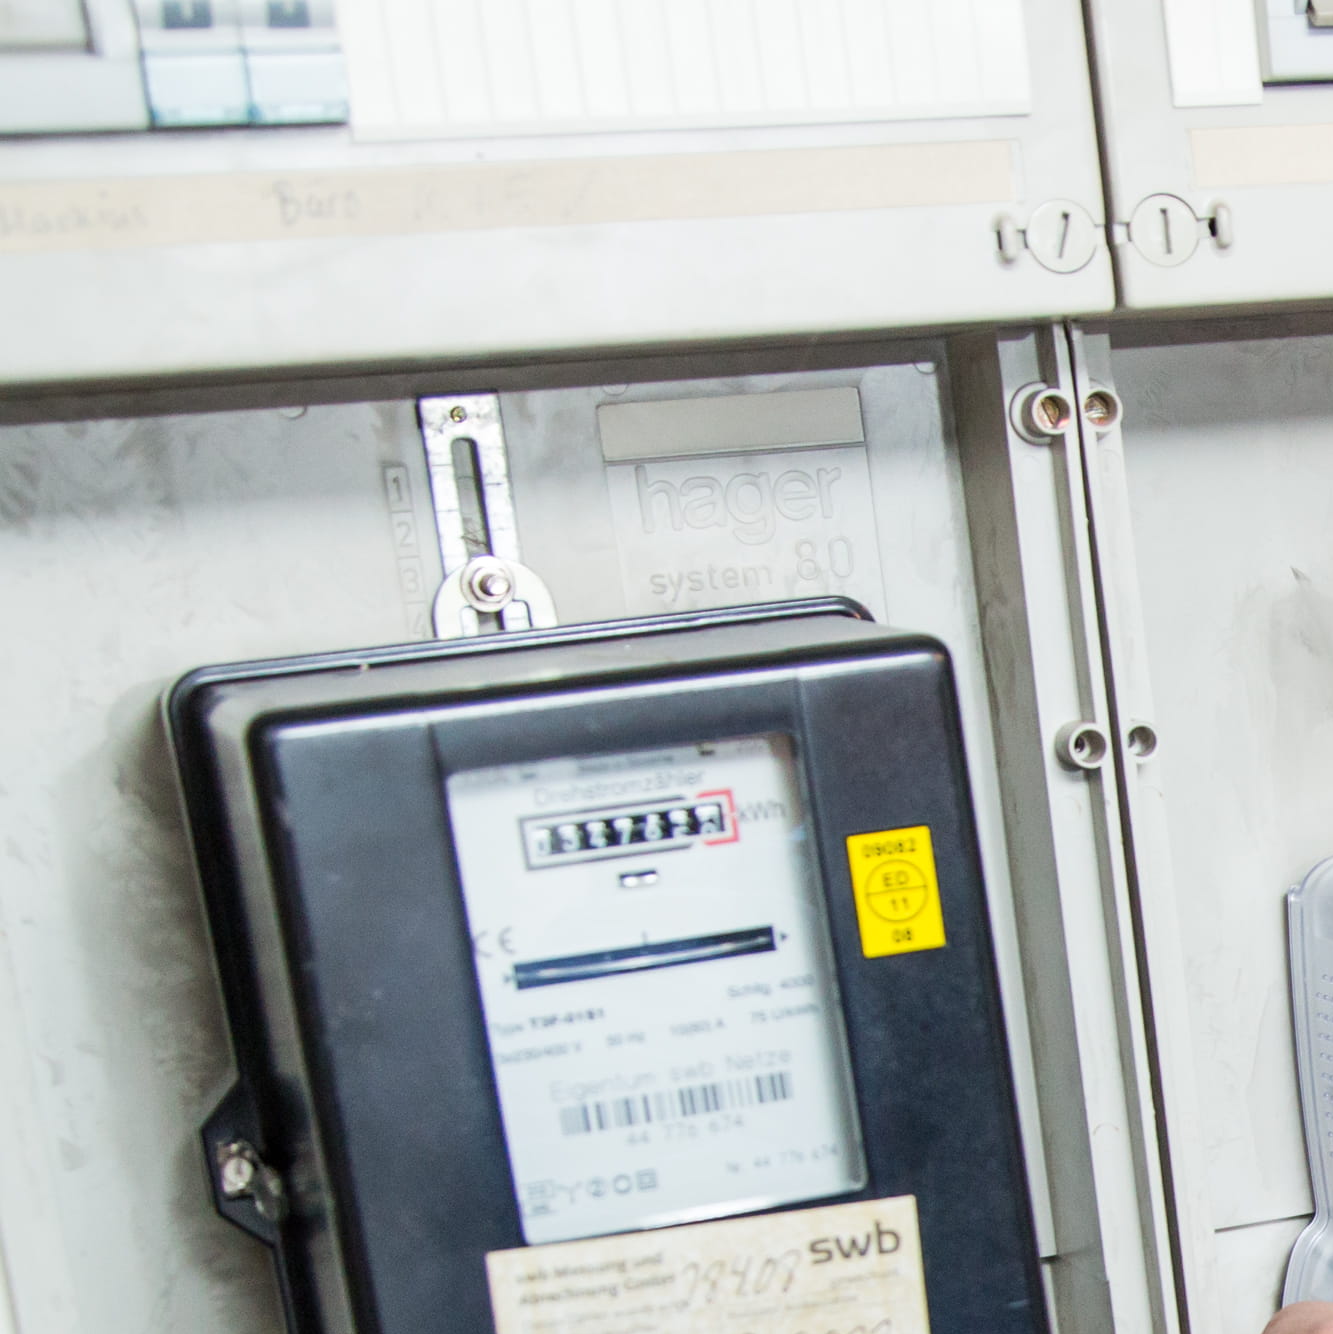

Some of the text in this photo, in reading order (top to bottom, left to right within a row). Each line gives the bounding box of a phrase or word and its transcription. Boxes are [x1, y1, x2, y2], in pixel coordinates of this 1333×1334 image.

[634, 464, 842, 545] hager
[650, 536, 854, 603] system 80
[810, 1221, 901, 1266] swb
